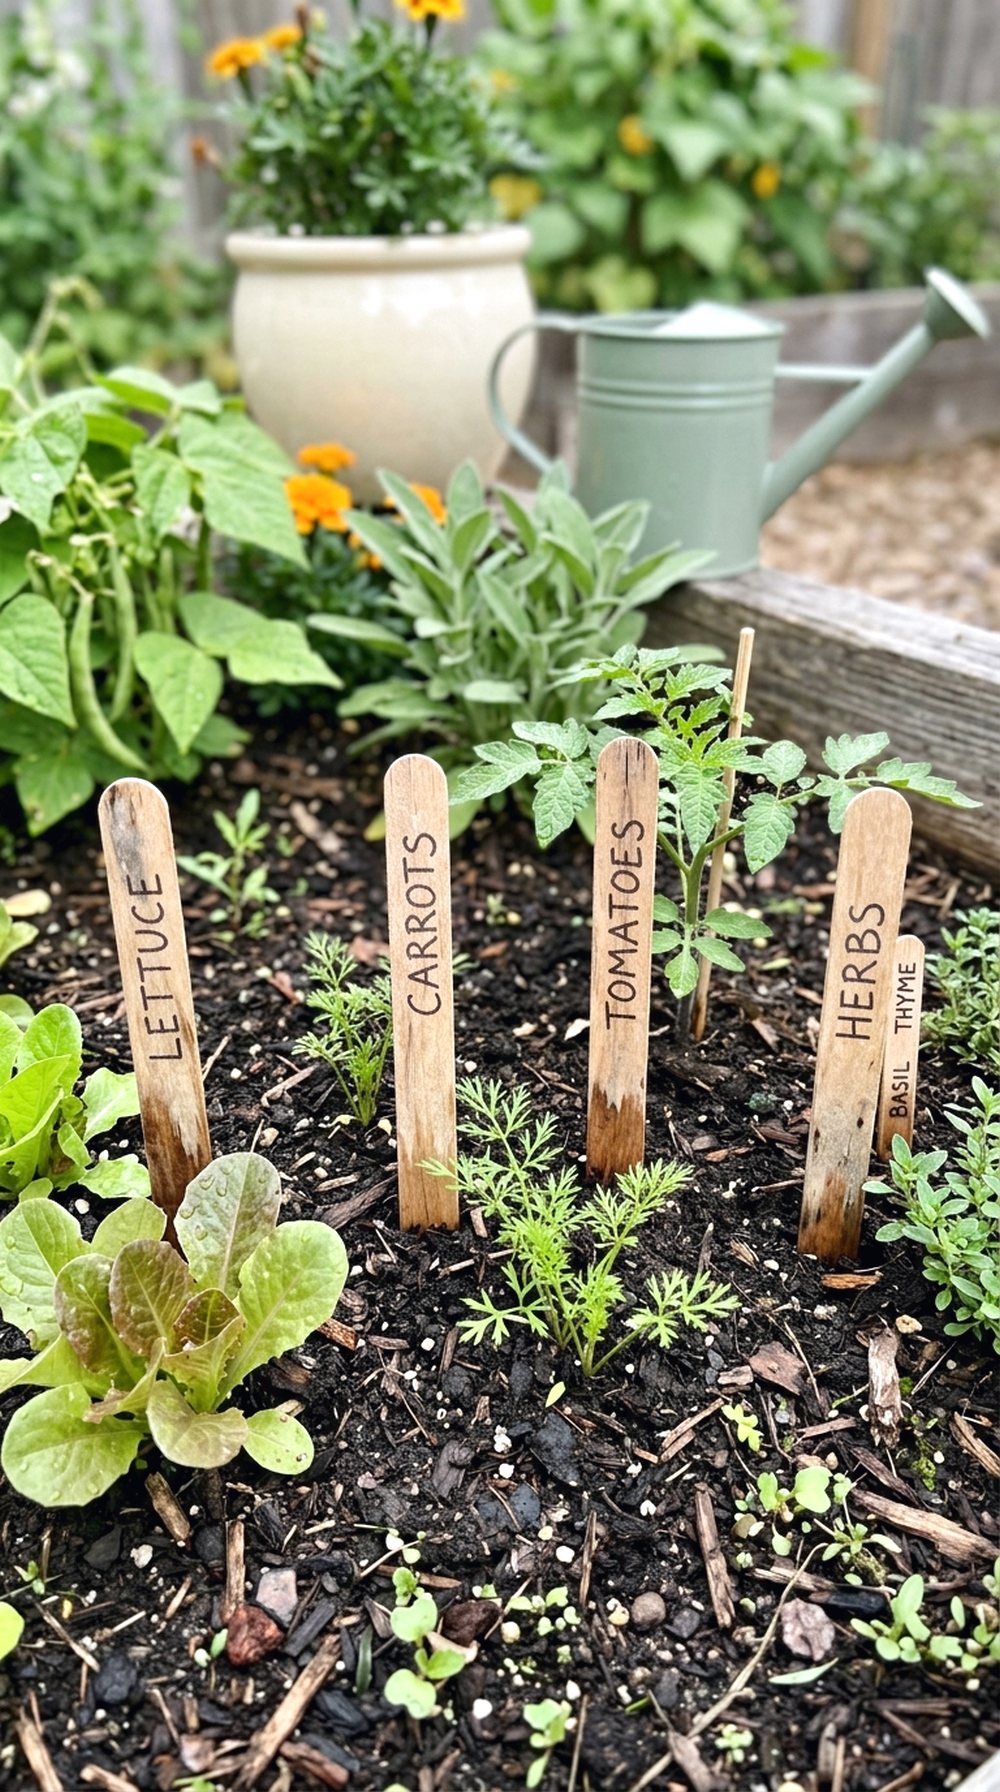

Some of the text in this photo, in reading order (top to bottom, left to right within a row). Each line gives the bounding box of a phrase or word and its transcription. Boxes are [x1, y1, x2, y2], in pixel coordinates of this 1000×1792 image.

[126, 873, 183, 1061] LETTUCE
[402, 831, 441, 1016] CARROTS
[605, 819, 645, 1030] TOMATOES
[836, 902, 885, 1041] HERBS
[888, 962, 916, 1118] BASIL THYME
